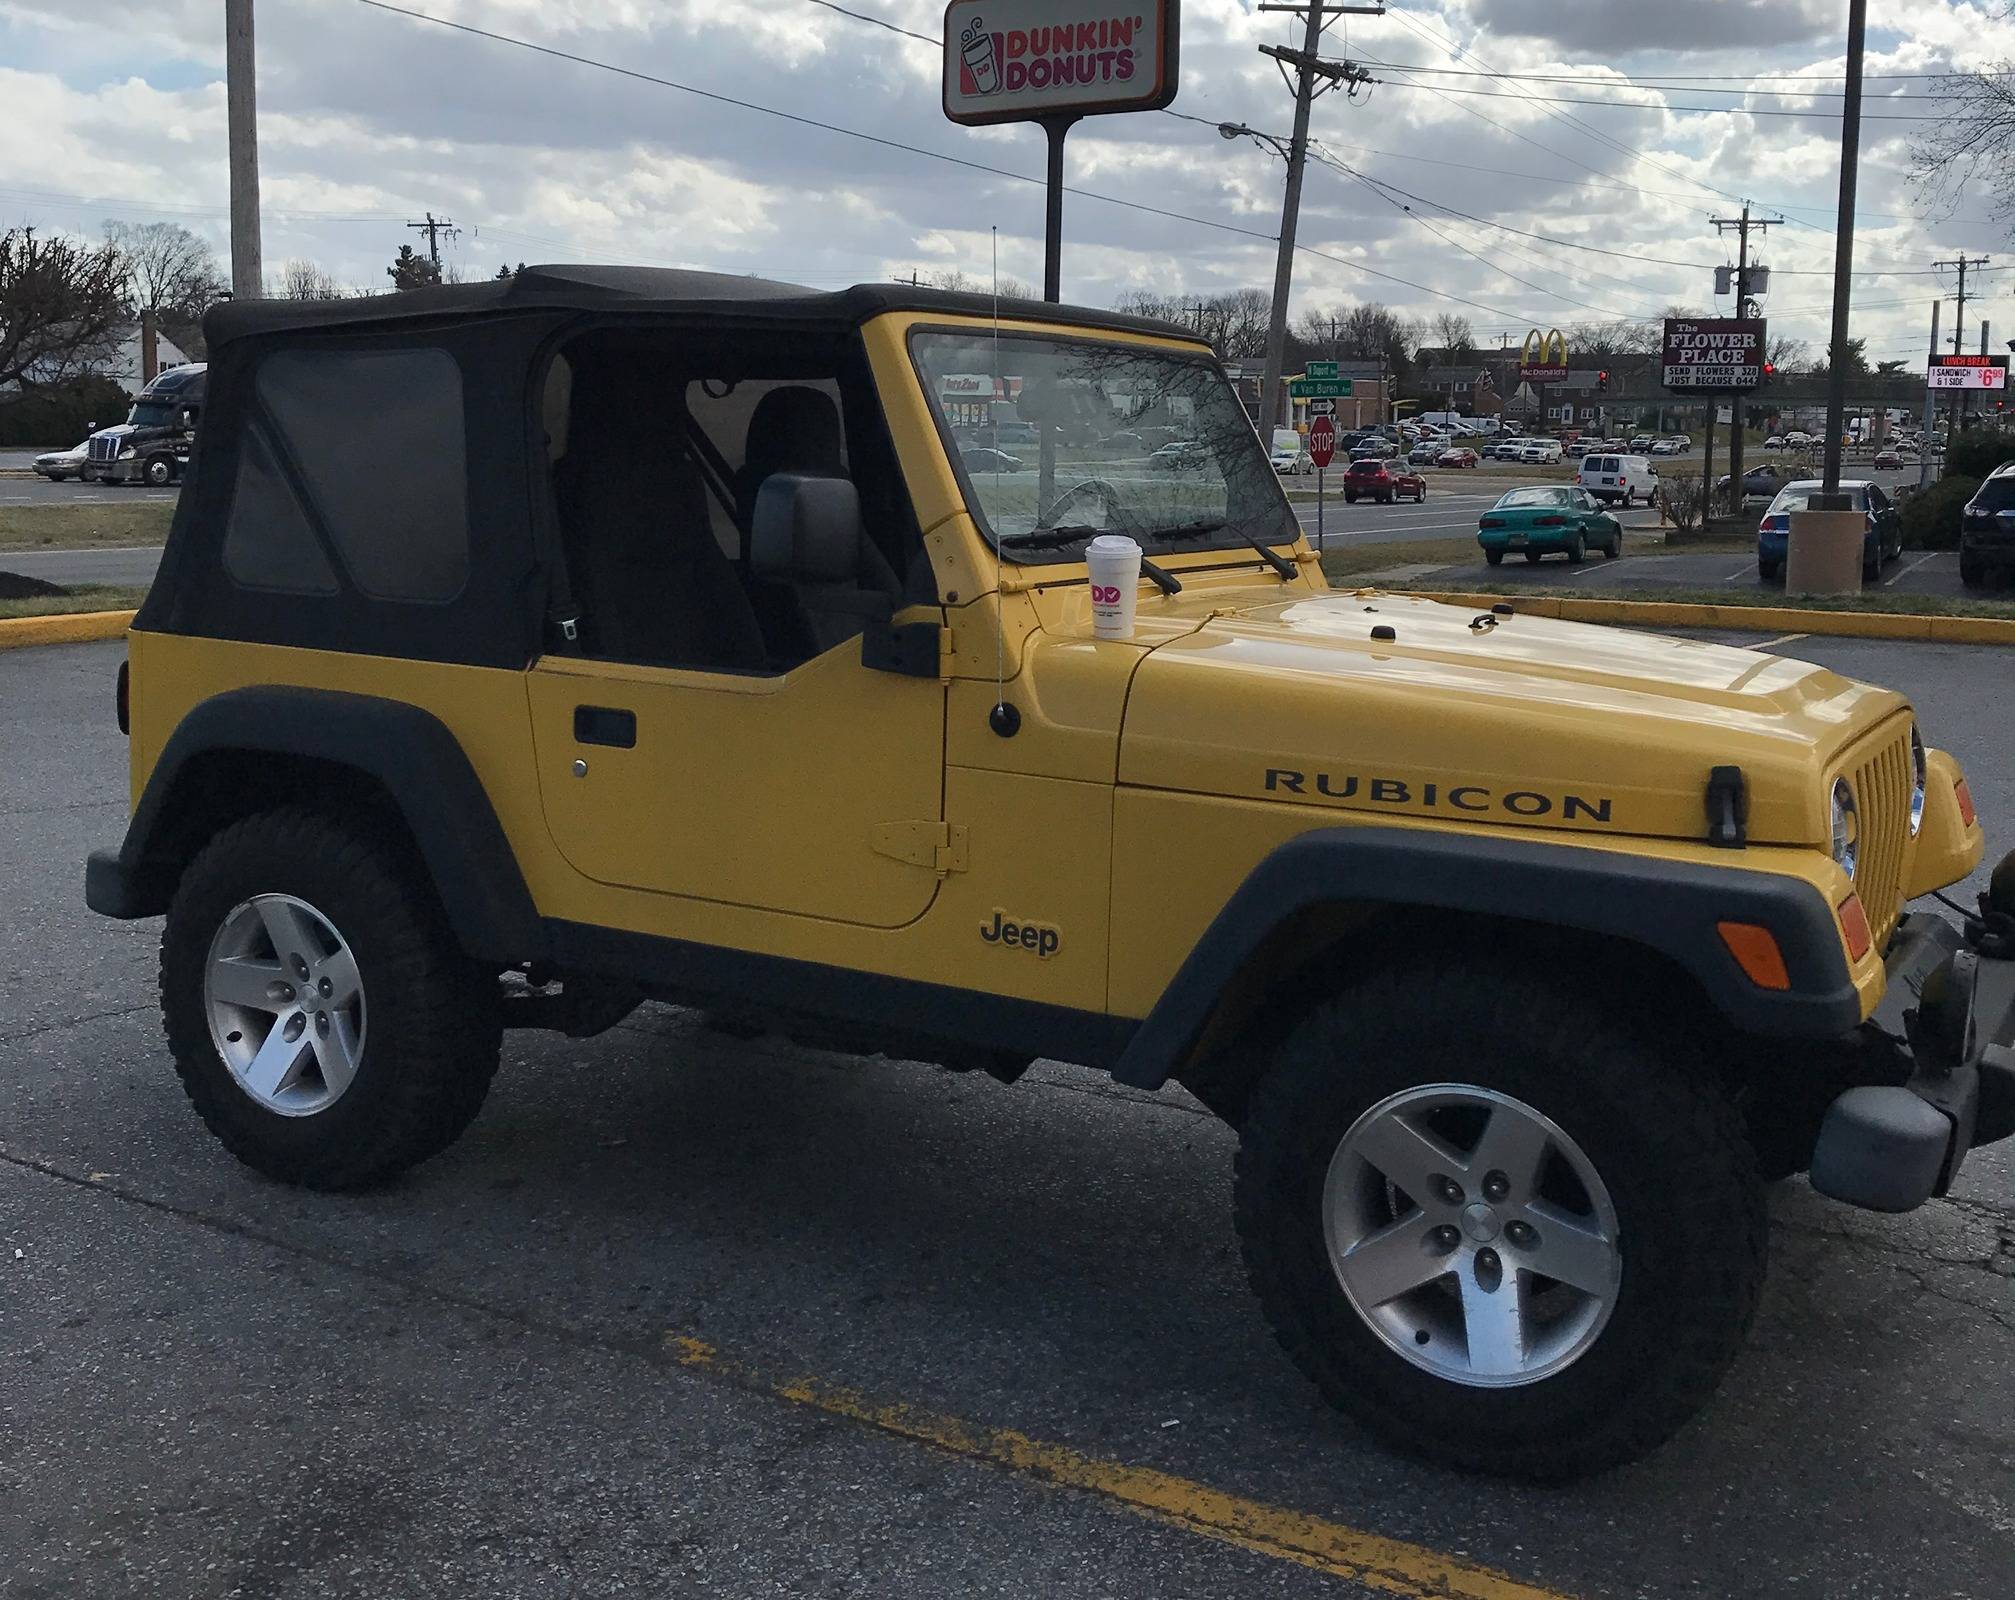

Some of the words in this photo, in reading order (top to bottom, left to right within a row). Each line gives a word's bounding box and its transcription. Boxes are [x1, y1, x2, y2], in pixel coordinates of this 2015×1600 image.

[1006, 15, 1143, 59] DUNKIN'
[1006, 49, 1136, 91] DONUTS
[1676, 323, 1698, 332] The
[1669, 333, 1757, 348] FLOWER
[1678, 349, 1745, 364] PLACE
[1943, 356, 1965, 366] LUNCH
[1967, 356, 1991, 366] BREAK
[1668, 367, 1691, 375] SEND
[1696, 367, 1735, 375] FLOWERS
[1741, 367, 1757, 375] 328
[1937, 368, 1971, 377] SANDWICH
[1668, 376, 1691, 385] JUST
[1696, 376, 1733, 385] BECAUSE
[1949, 377, 1963, 386] SIDE
[1317, 383, 1339, 394] Buren
[1311, 432, 1334, 452] STOP
[1265, 769, 1612, 822] RUBICON
[980, 911, 1060, 957] Jeep
